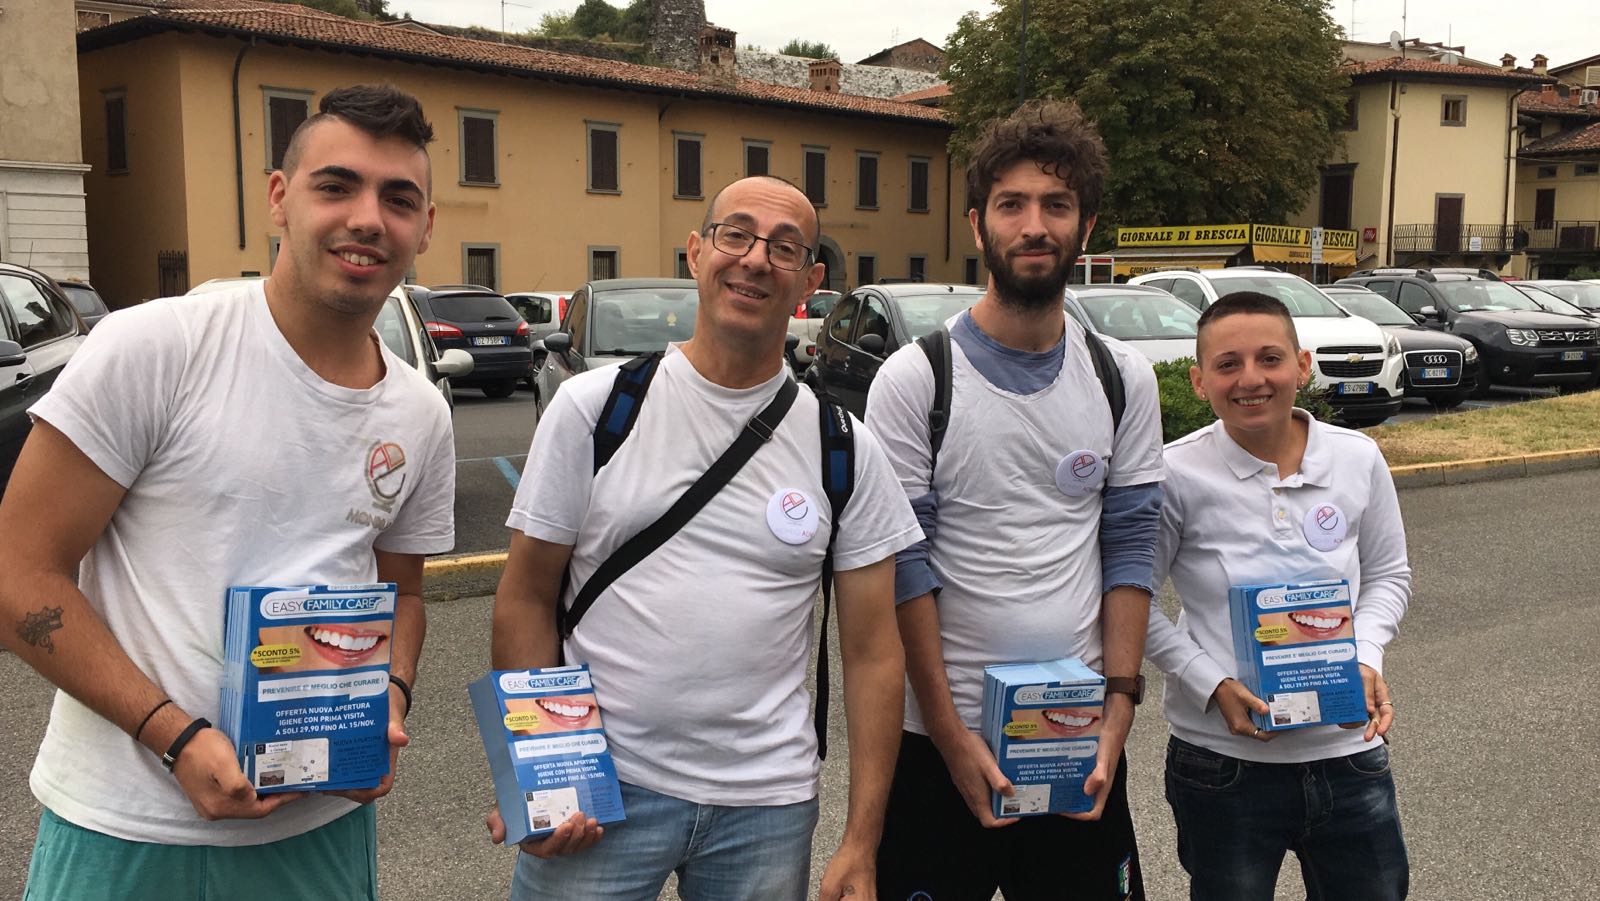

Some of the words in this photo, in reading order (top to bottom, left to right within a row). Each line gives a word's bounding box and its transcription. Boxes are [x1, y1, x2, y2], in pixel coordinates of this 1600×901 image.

[1120, 231, 1173, 242] GIORNALE
[1178, 230, 1191, 240] DI
[1194, 229, 1246, 240] BRESCIA
[1255, 226, 1300, 244] GIORNALE
[1323, 231, 1354, 247] RESCIA
[1264, 595, 1284, 604] EASY
[1287, 593, 1312, 602] FAMILY
[1314, 590, 1334, 599] CARE
[273, 601, 303, 612] EASY
[307, 599, 344, 610] FAMILY
[346, 598, 375, 609] CARE
[508, 680, 528, 689] EASY
[531, 679, 555, 688] FAMILY
[557, 677, 576, 685] CARE
[262, 686, 300, 694] PREVENIRE
[1044, 691, 1069, 699] FAMILY
[1071, 690, 1092, 698] CARE
[276, 708, 307, 717] OFFERTA
[335, 702, 370, 712] APERTURA
[280, 718, 302, 726] IGIENE
